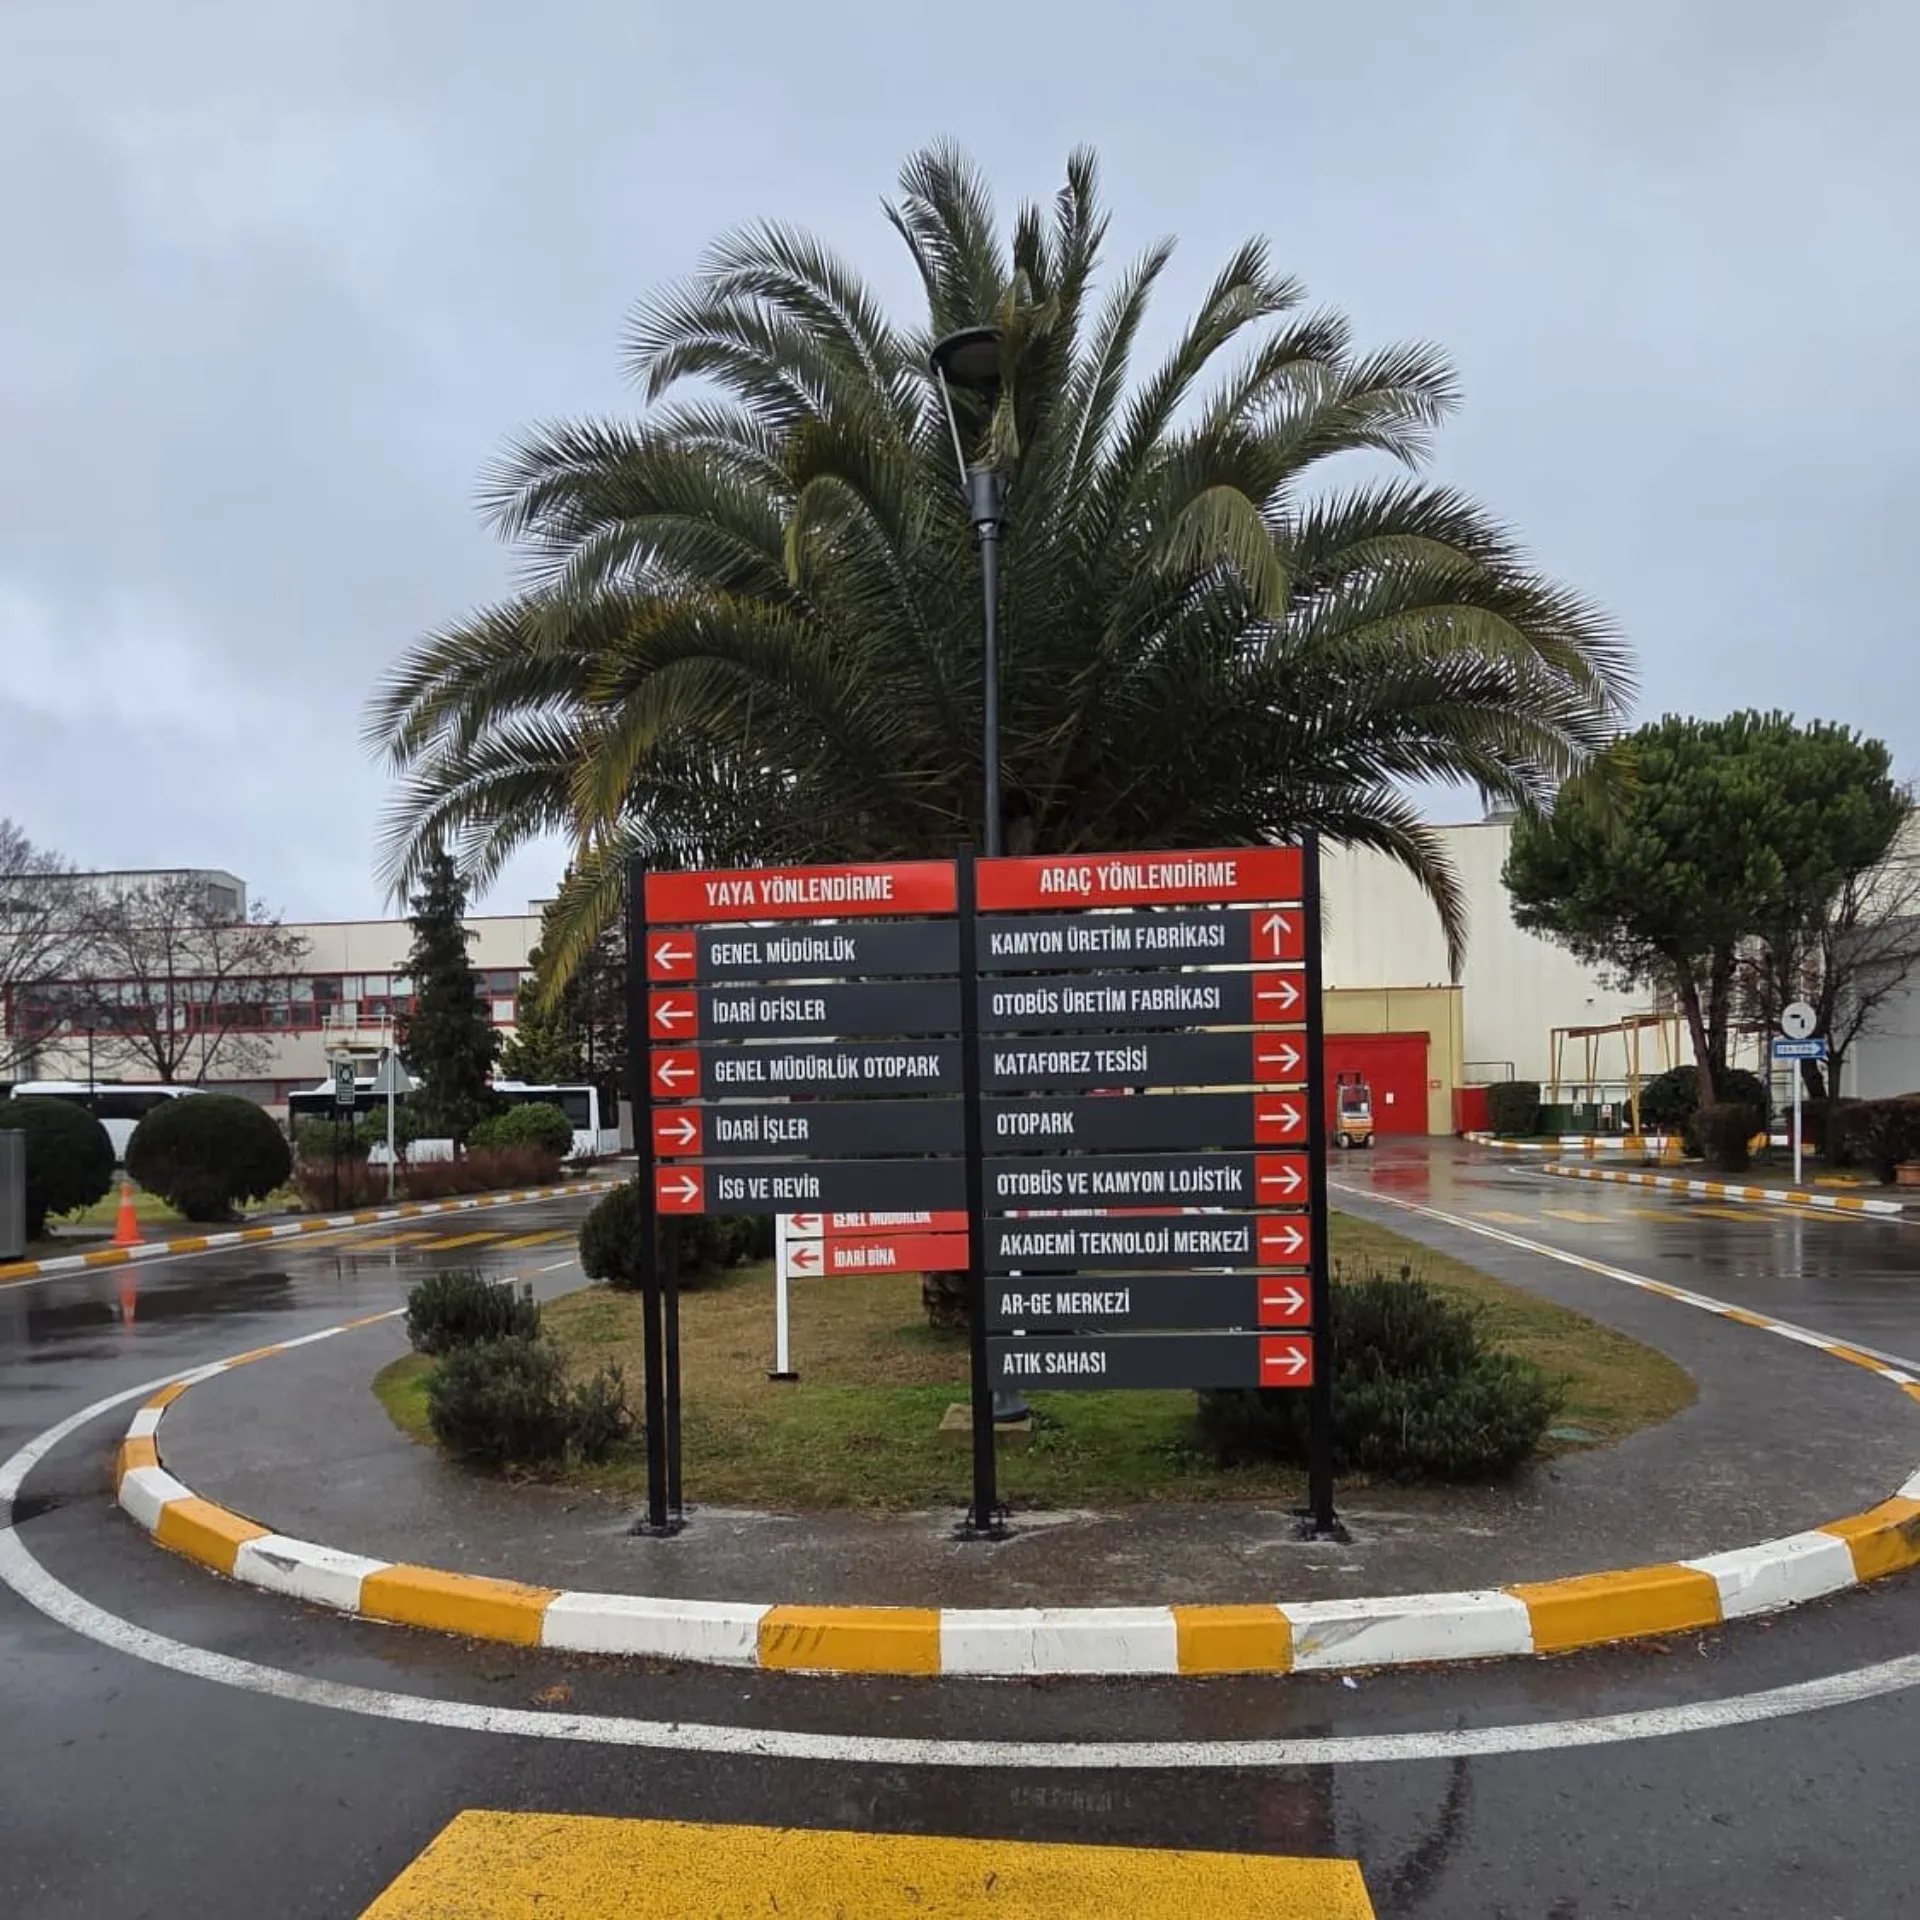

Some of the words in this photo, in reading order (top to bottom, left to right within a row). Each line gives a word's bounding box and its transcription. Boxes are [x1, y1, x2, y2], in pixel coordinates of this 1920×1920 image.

[706, 881, 754, 905] YAYA
[761, 874, 892, 903] YÖNLENDİRME
[1041, 868, 1091, 895] ARAÇ
[1097, 859, 1236, 890] YÖNLENDİRME
[712, 943, 762, 965] GENEL
[767, 936, 854, 962] MÜDÜRLÜK
[992, 932, 1062, 954] KAMYON
[1068, 925, 1131, 951] ÜRETİM
[1136, 922, 1224, 948] FABRİKASI
[713, 998, 755, 1023] İDARİ
[760, 997, 825, 1021] OFİSLER
[993, 989, 1058, 1015] OTOBÜS
[1063, 987, 1125, 1013] ÜRETİM
[1132, 985, 1219, 1010] FABRİKASI
[716, 1060, 766, 1081] GENEL
[770, 1054, 858, 1080] MÜDÜRLÜK
[864, 1056, 939, 1077] OTOPARK
[995, 1052, 1090, 1074] KATAFOREZ
[1095, 1046, 1146, 1071] TESİSİ
[717, 1116, 758, 1140] İDARİ
[763, 1115, 808, 1144] İŞLER
[997, 1112, 1073, 1134] OTOPARK
[719, 1175, 744, 1199] İSG
[749, 1178, 768, 1198] VE
[773, 1173, 819, 1198] REVİR
[998, 1170, 1062, 1194] OTOBÜS
[1067, 1173, 1088, 1193] VE
[1093, 1172, 1164, 1193] KAMYON
[1170, 1166, 1242, 1192] LOJİSTİK
[1001, 1230, 1074, 1255] AKADEMİ
[1080, 1228, 1168, 1254] TEKNOLOJİ
[1175, 1227, 1248, 1252] MERKEZİ
[1001, 1294, 1051, 1314] AR-GE
[1057, 1288, 1129, 1313] MERKEZİ
[1004, 1353, 1041, 1373] ATIK
[1046, 1352, 1105, 1373] SAHASI
